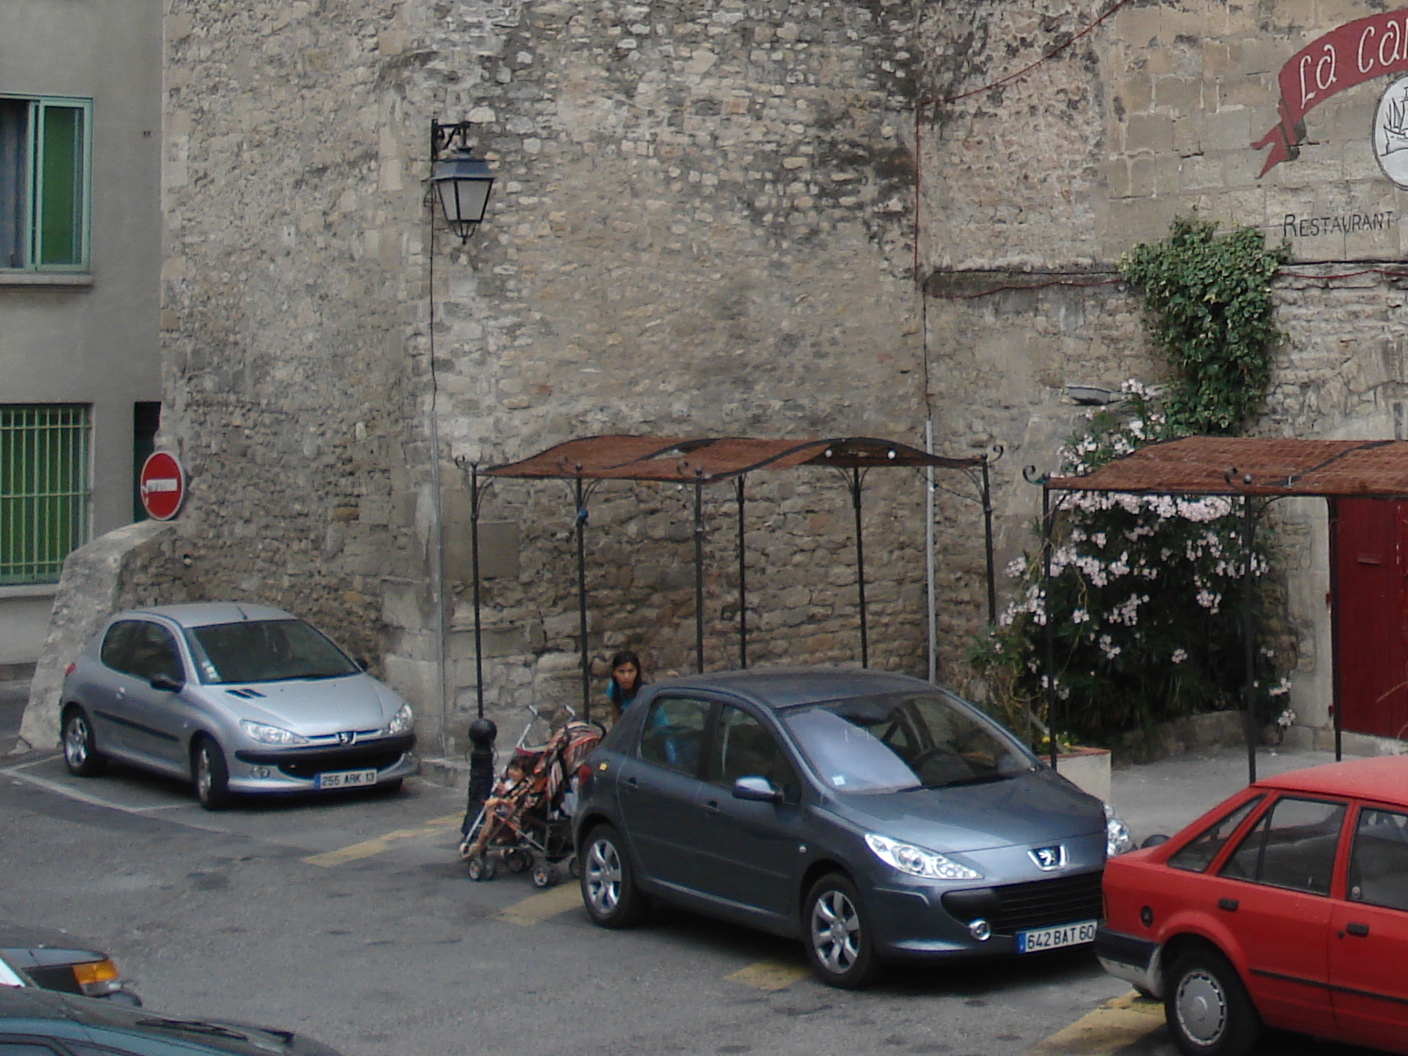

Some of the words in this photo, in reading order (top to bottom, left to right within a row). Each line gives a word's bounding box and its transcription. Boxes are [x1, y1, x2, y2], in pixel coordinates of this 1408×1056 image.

[1299, 44, 1338, 109] La
[1283, 210, 1394, 237] RESTAURANT
[321, 774, 341, 787] 255
[344, 773, 362, 785] ARK
[365, 772, 375, 783] 13
[1027, 931, 1051, 950] 642
[1054, 927, 1077, 945] BAT
[1079, 924, 1095, 941] 60
